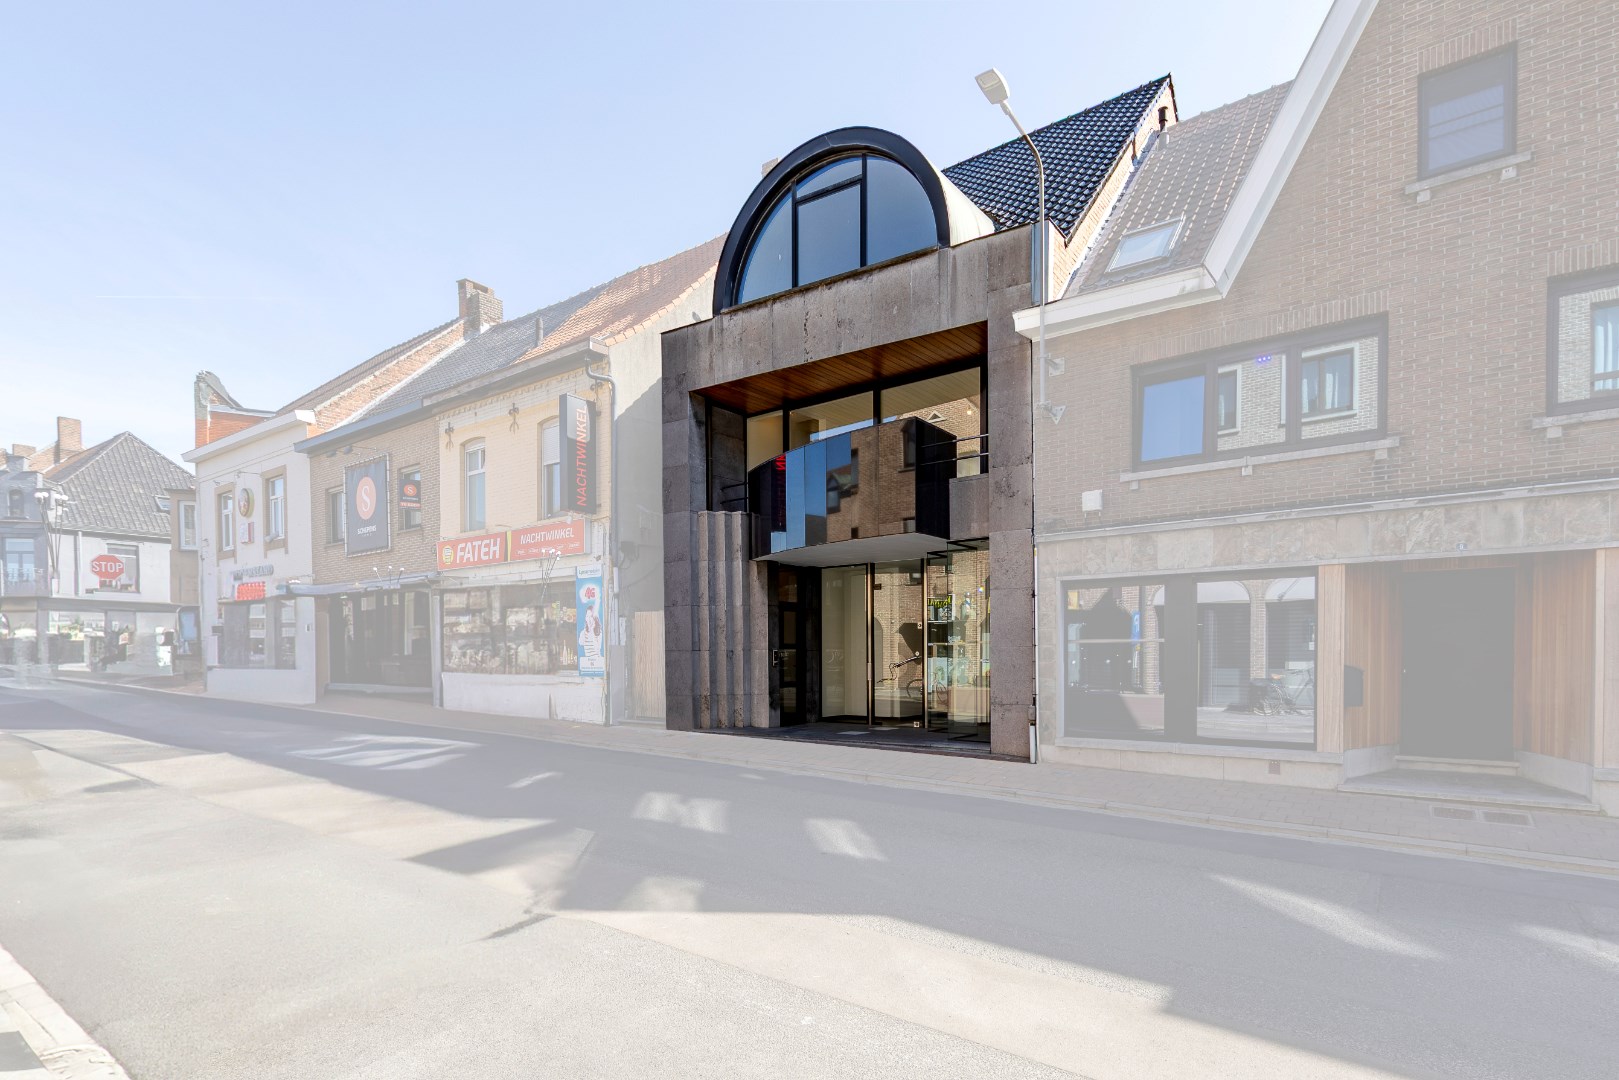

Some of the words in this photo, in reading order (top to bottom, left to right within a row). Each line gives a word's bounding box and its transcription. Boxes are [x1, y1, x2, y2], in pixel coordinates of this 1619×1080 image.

[575, 405, 588, 507] NACHTWINKEL
[361, 485, 371, 512] S
[520, 527, 575, 545] NACHTWINKEL
[456, 537, 501, 564] FATEH
[92, 561, 124, 573] STOP
[584, 586, 596, 600] 4G
